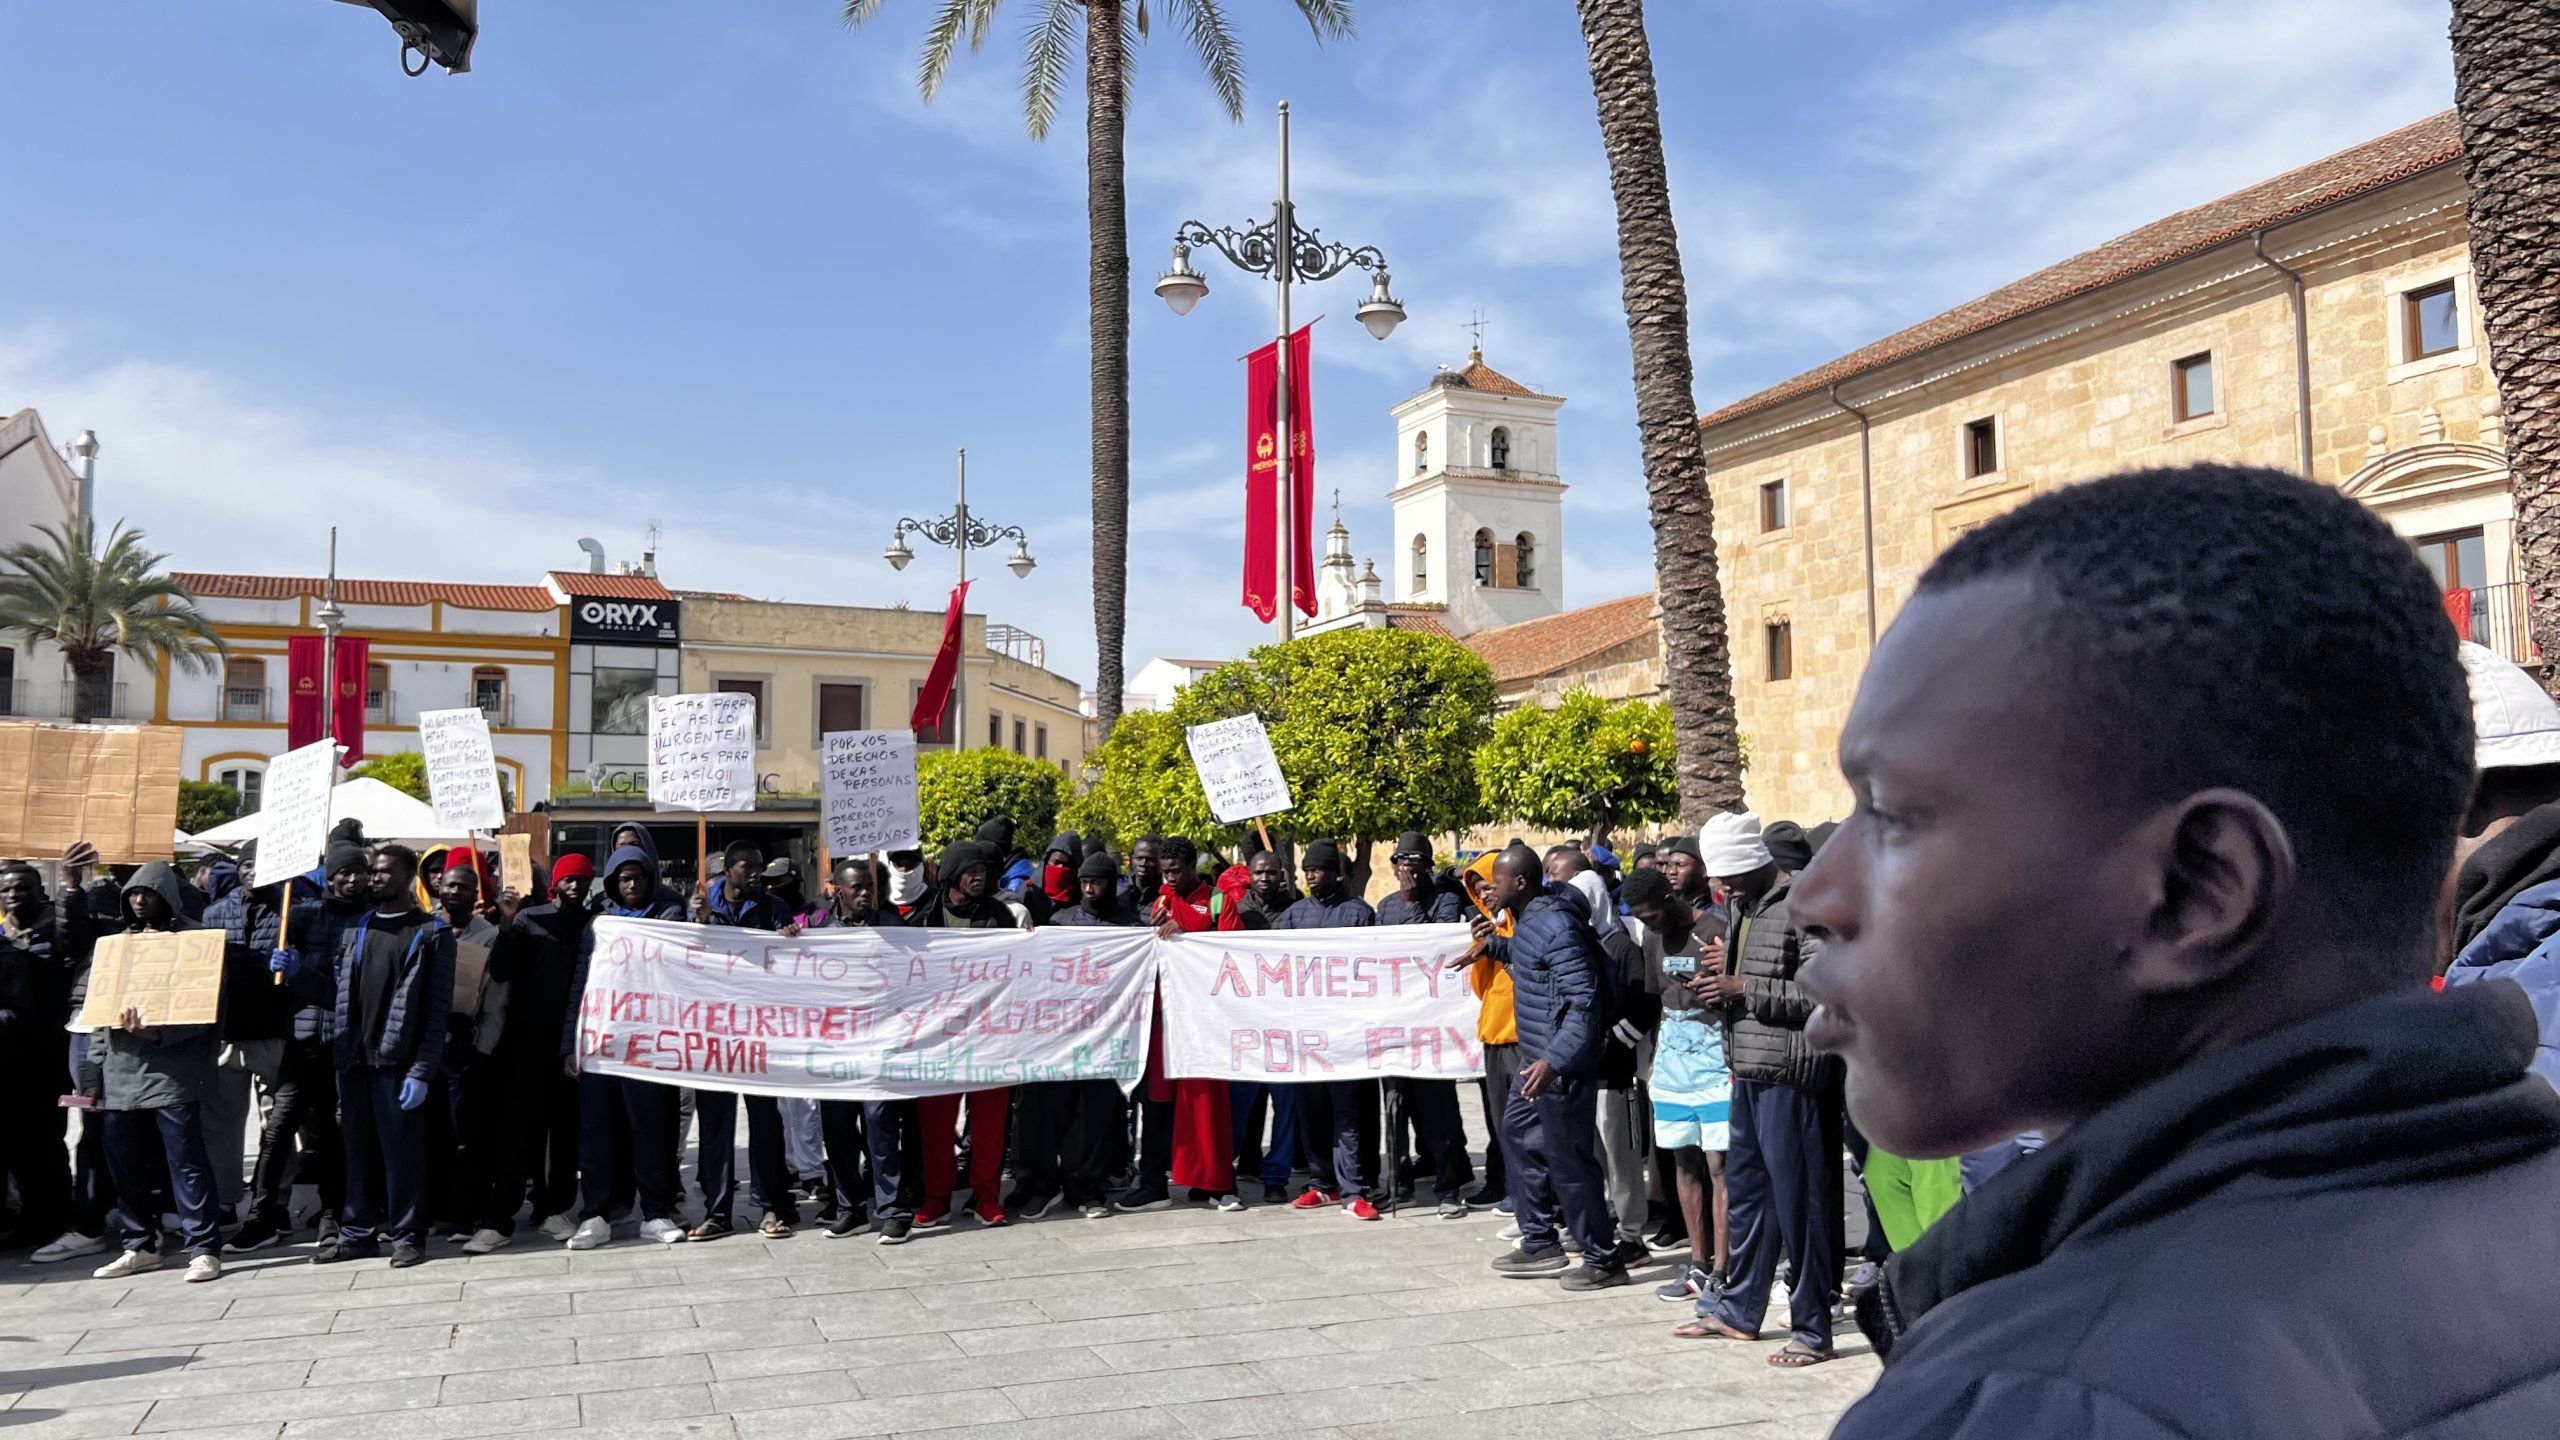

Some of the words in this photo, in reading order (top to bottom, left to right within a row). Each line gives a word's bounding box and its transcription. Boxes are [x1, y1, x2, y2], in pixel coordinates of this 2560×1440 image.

[581, 602, 658, 627] ORYX
[713, 698, 747, 710] PARA
[661, 717, 677, 728] EL
[831, 736, 856, 752] POR
[861, 734, 888, 747] LOS
[717, 750, 749, 764] PARA
[827, 750, 899, 765] DERECHOS
[1202, 743, 1243, 763] COMFORT
[662, 770, 676, 783] EL
[830, 768, 847, 780] DE
[850, 765, 877, 778] LAS
[843, 774, 912, 791] PERSONAS
[832, 797, 857, 812] POR
[863, 795, 886, 809] LOS
[828, 806, 894, 825] DERECHOS
[834, 825, 849, 835] DE
[855, 820, 877, 831] LAS
[836, 828, 912, 849] PERSONAS
[609, 936, 889, 993] QUEREMOS
[581, 1027, 616, 1059] DE
[624, 1029, 769, 1074] ESPAÑA
[1231, 1028, 1335, 1075] POR
